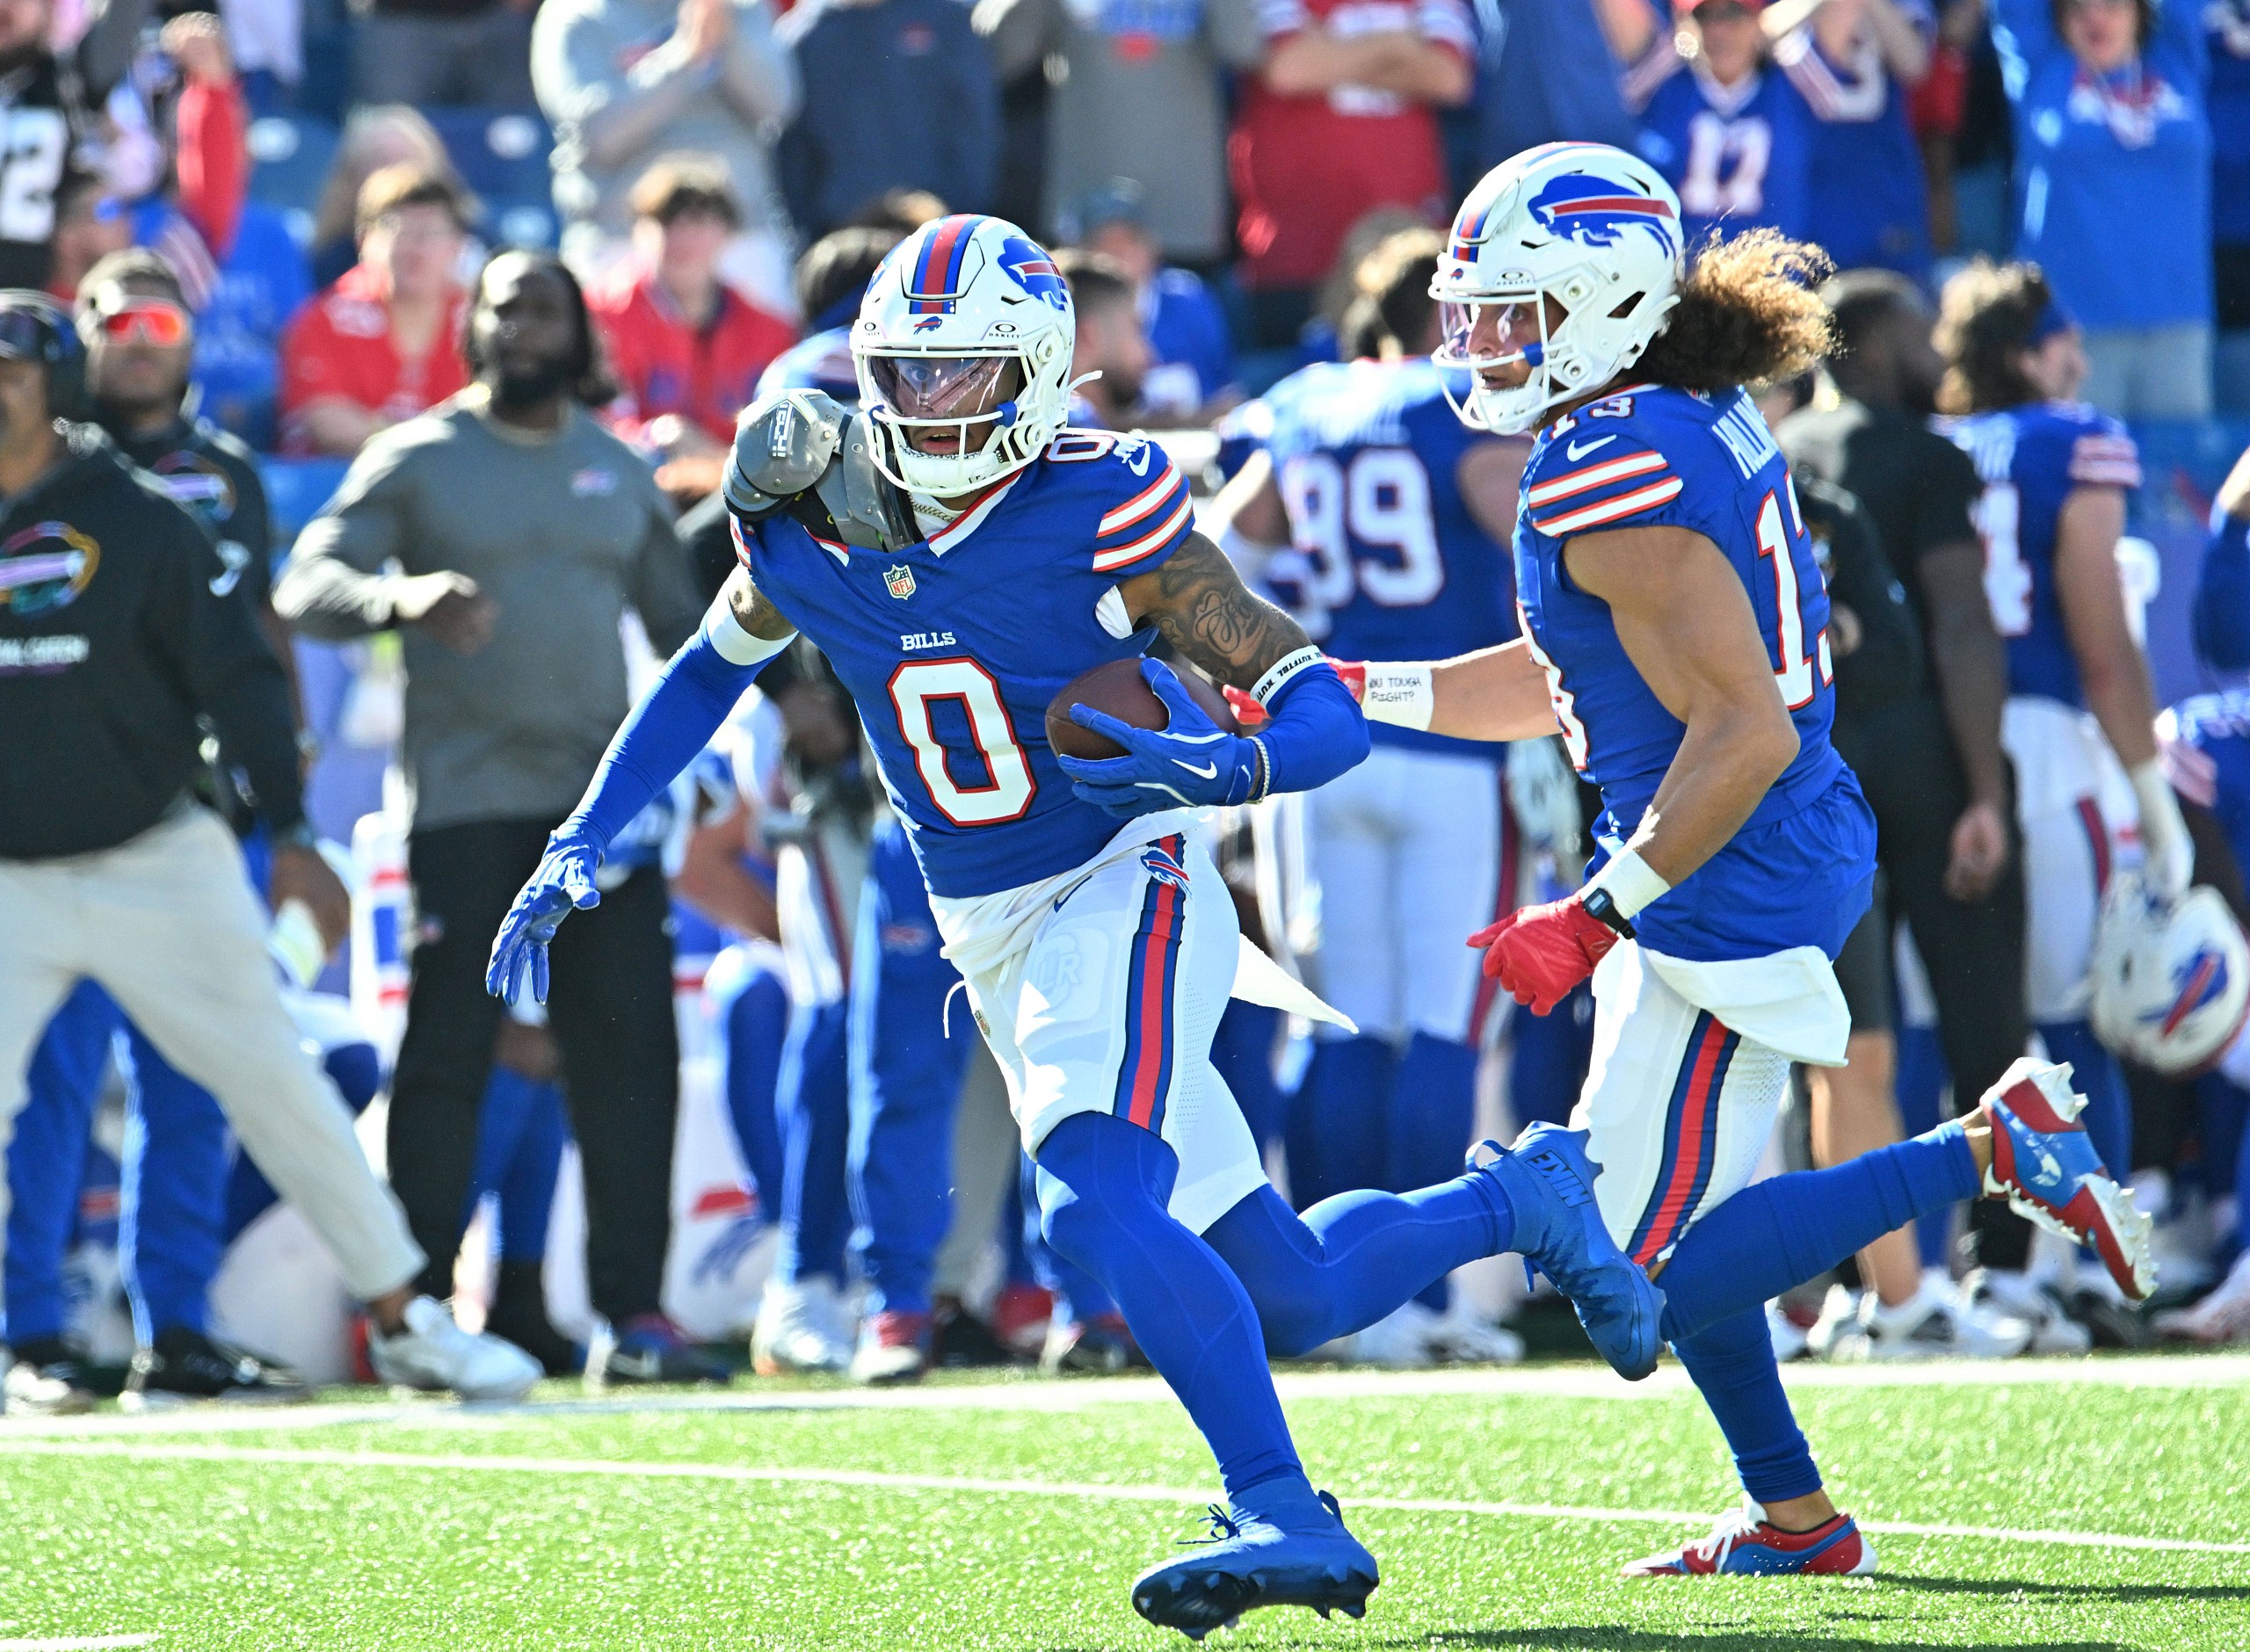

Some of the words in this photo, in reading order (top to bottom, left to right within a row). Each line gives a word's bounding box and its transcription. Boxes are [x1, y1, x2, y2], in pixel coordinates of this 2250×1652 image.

[1044, 433, 1115, 463] 0
[1281, 447, 1444, 608] 99
[891, 579, 912, 594] NFL
[900, 632, 956, 651] BILLS
[1388, 677, 1422, 687] TOUGH
[1371, 691, 1415, 702] RIGHT?
[886, 655, 1039, 829] 0
[1526, 1149, 1593, 1208] NIKE
